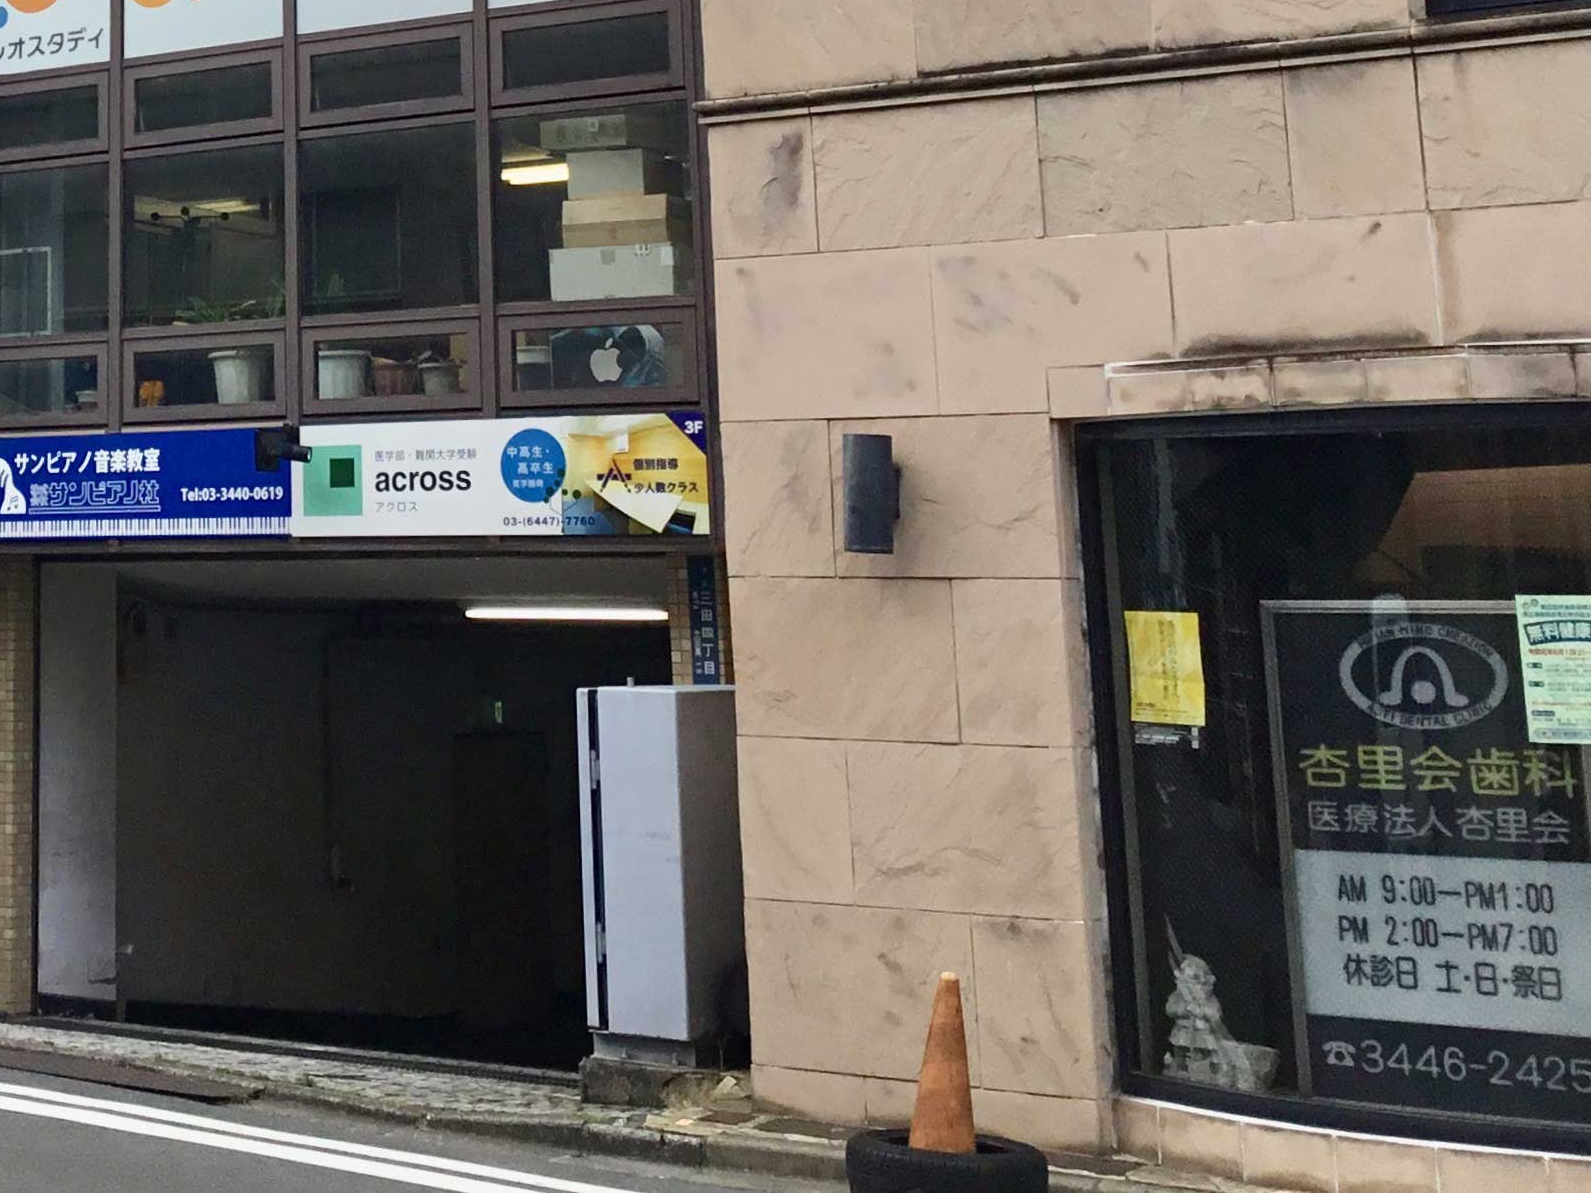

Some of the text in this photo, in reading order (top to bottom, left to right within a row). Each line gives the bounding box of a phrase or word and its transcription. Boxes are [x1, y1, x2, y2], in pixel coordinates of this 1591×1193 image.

[684, 421, 704, 435] 3F
[14, 447, 161, 475] サンピアノ音楽教室
[375, 448, 478, 463] 医学部・難関大学受験
[517, 461, 555, 475] 高卒生
[633, 458, 679, 471] 個別指導
[375, 469, 472, 493] across
[634, 481, 699, 494] 少人数クラス
[181, 486, 284, 503] Tel:03-3440-0619
[376, 501, 419, 513] アクロス
[503, 515, 595, 527] 03-(6447)-7760
[1298, 743, 1577, 798] 杏里会歯科
[1307, 801, 1570, 845] 医療法人杏里会
[1338, 874, 1367, 902] AM
[1338, 915, 1369, 944] PM
[1343, 953, 1562, 1001] 休診日 土・日・祭日
